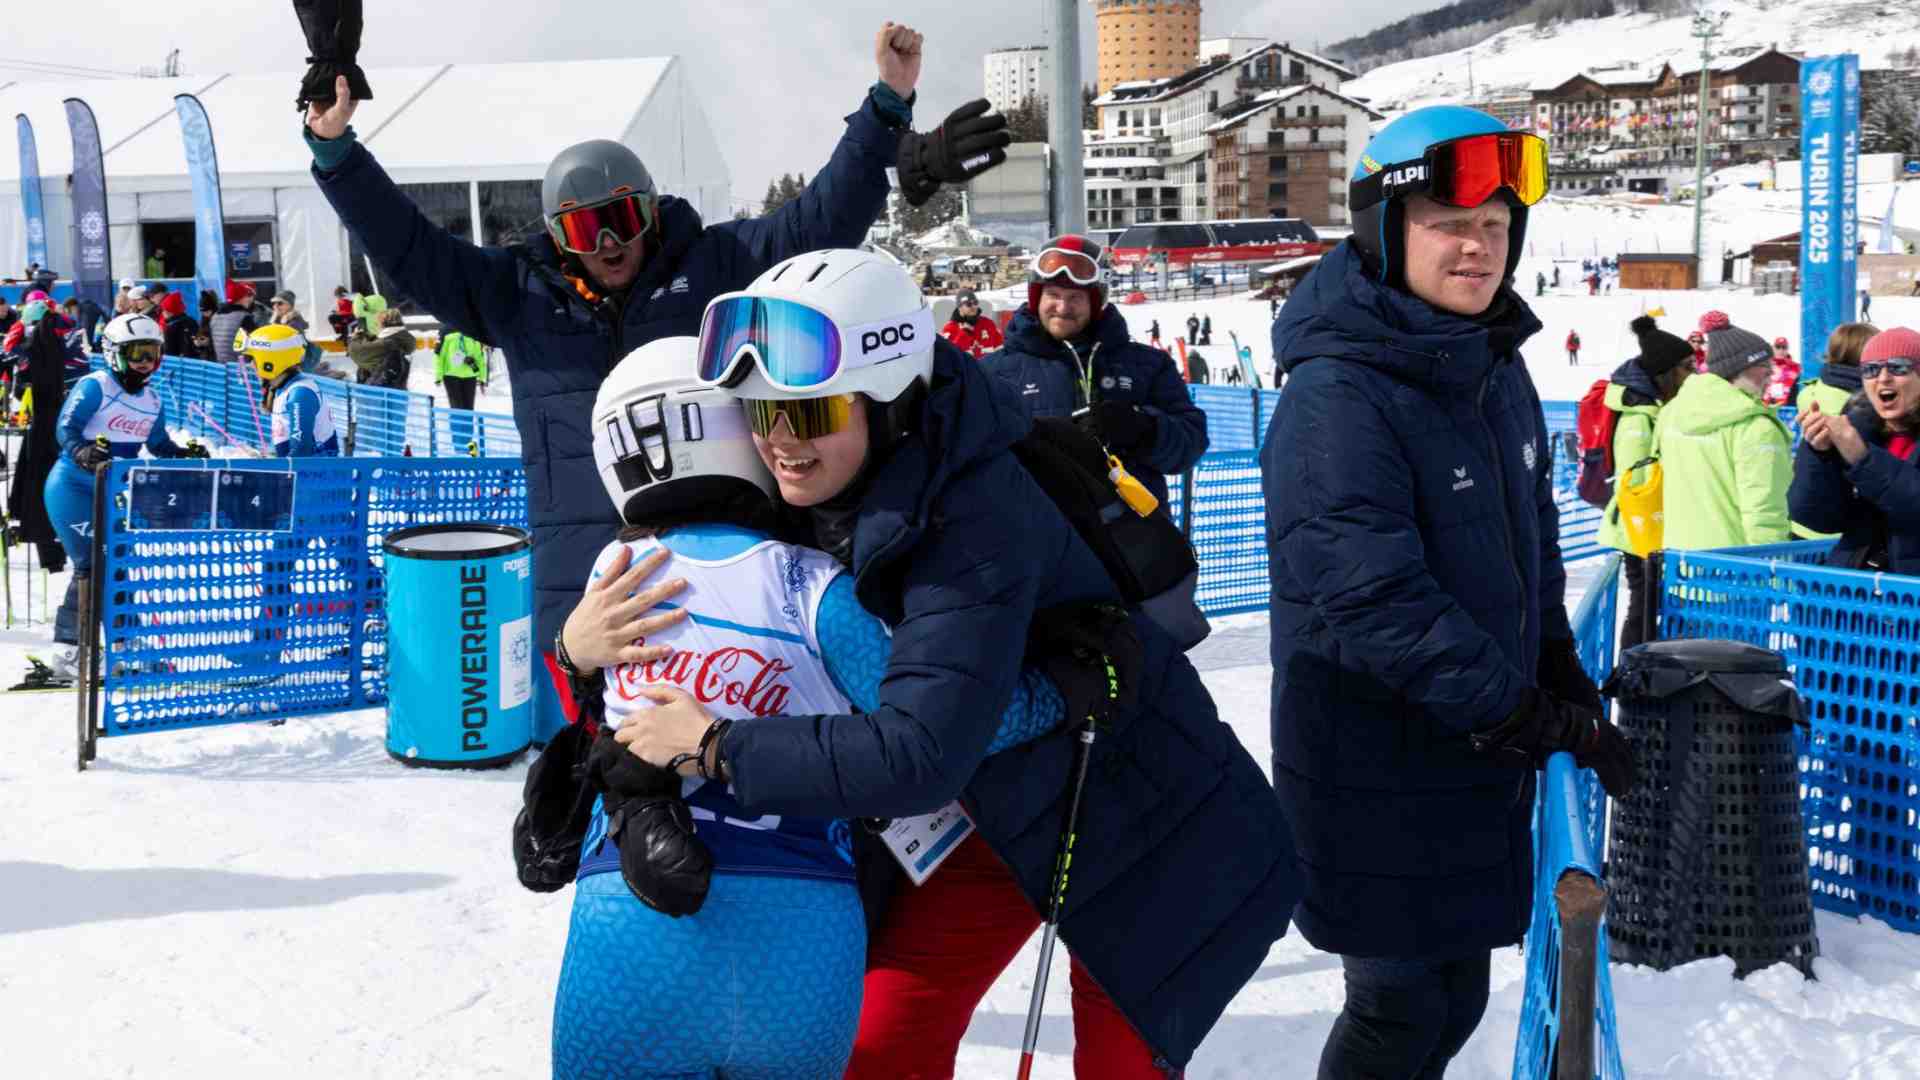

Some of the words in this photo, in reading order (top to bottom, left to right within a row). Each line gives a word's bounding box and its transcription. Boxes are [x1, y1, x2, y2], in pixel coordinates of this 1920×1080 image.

[1808, 132, 1830, 206] TURIN
[1842, 130, 1856, 204] TURIN
[1808, 209, 1830, 265] 2025
[167, 493, 177, 506] 2
[250, 495, 261, 507] 4
[460, 564, 488, 752] POWERADE
